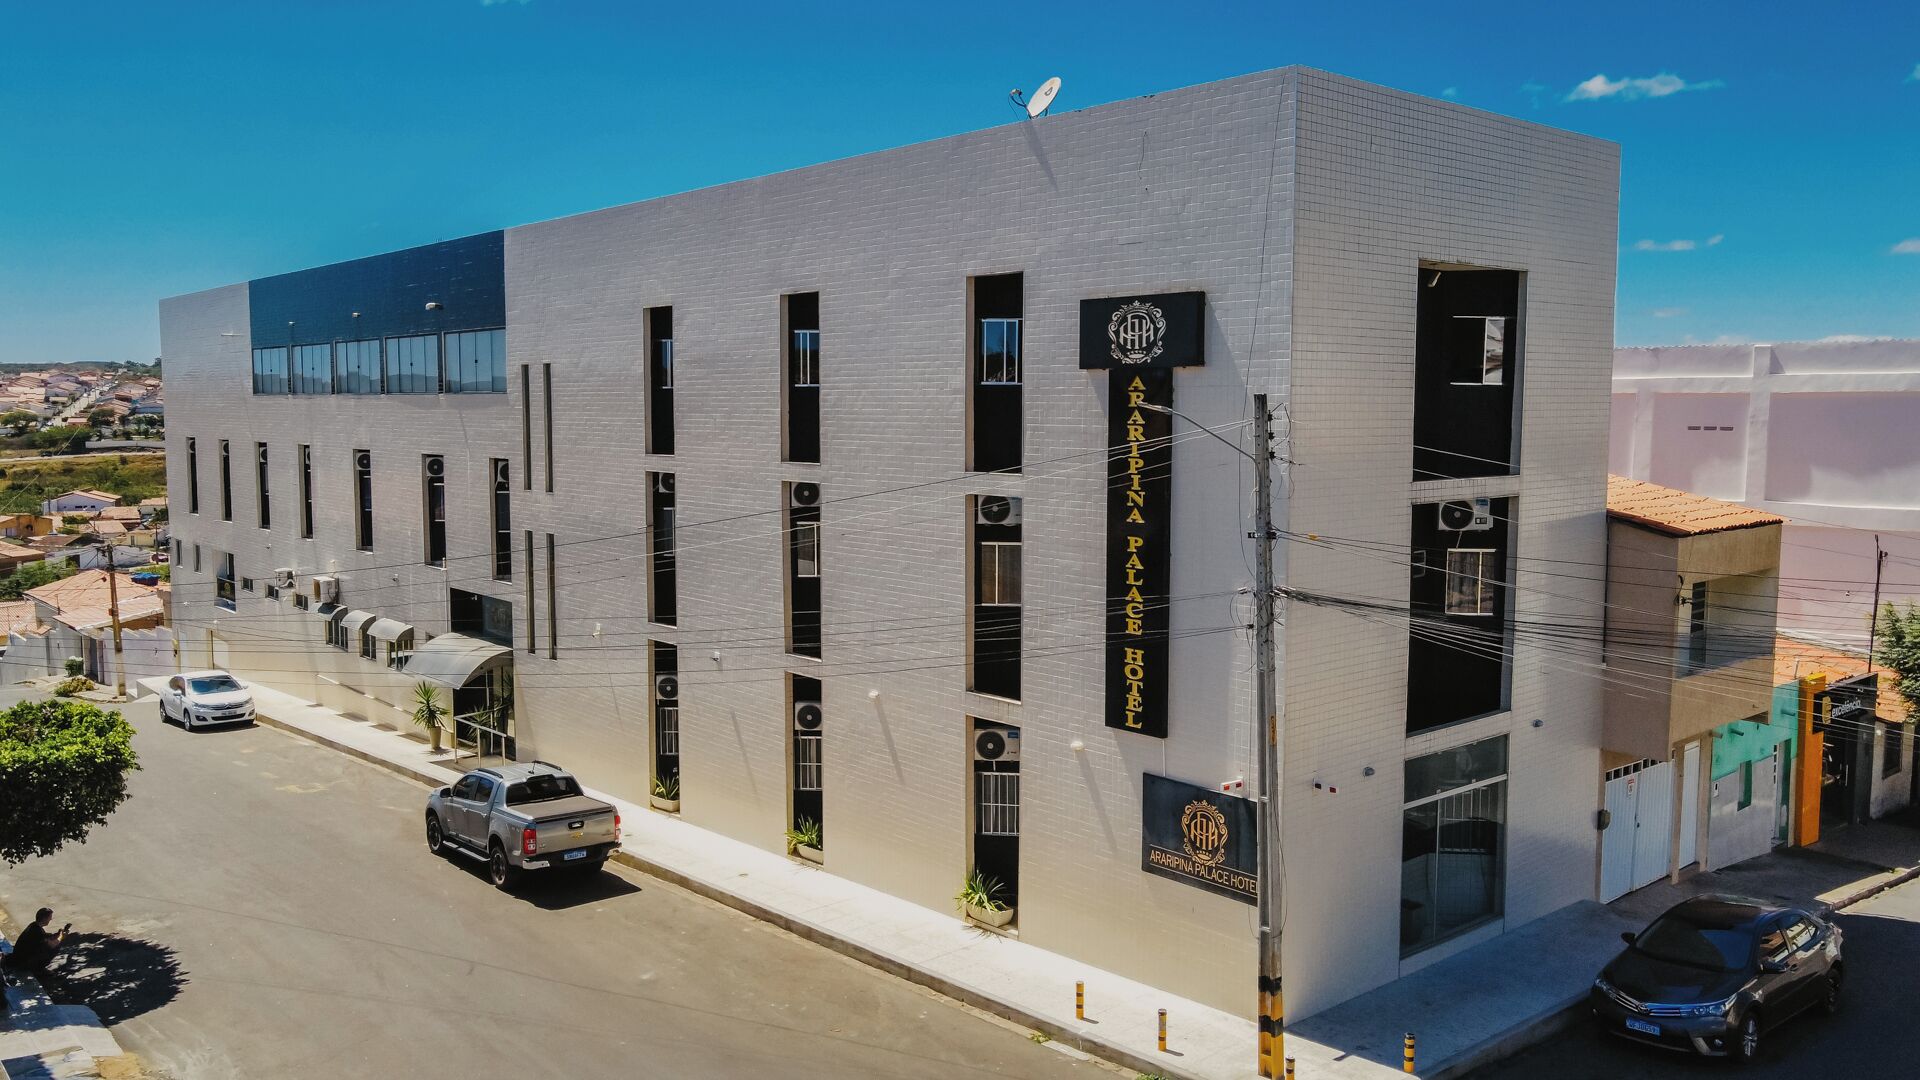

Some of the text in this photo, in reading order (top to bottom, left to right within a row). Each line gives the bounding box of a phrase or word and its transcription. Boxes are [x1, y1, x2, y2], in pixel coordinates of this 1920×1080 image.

[1124, 375, 1146, 729] ARARIPINA PALACE HOTEL
[1149, 850, 1193, 873] ARARIPINA
[1195, 864, 1229, 884] PALACE
